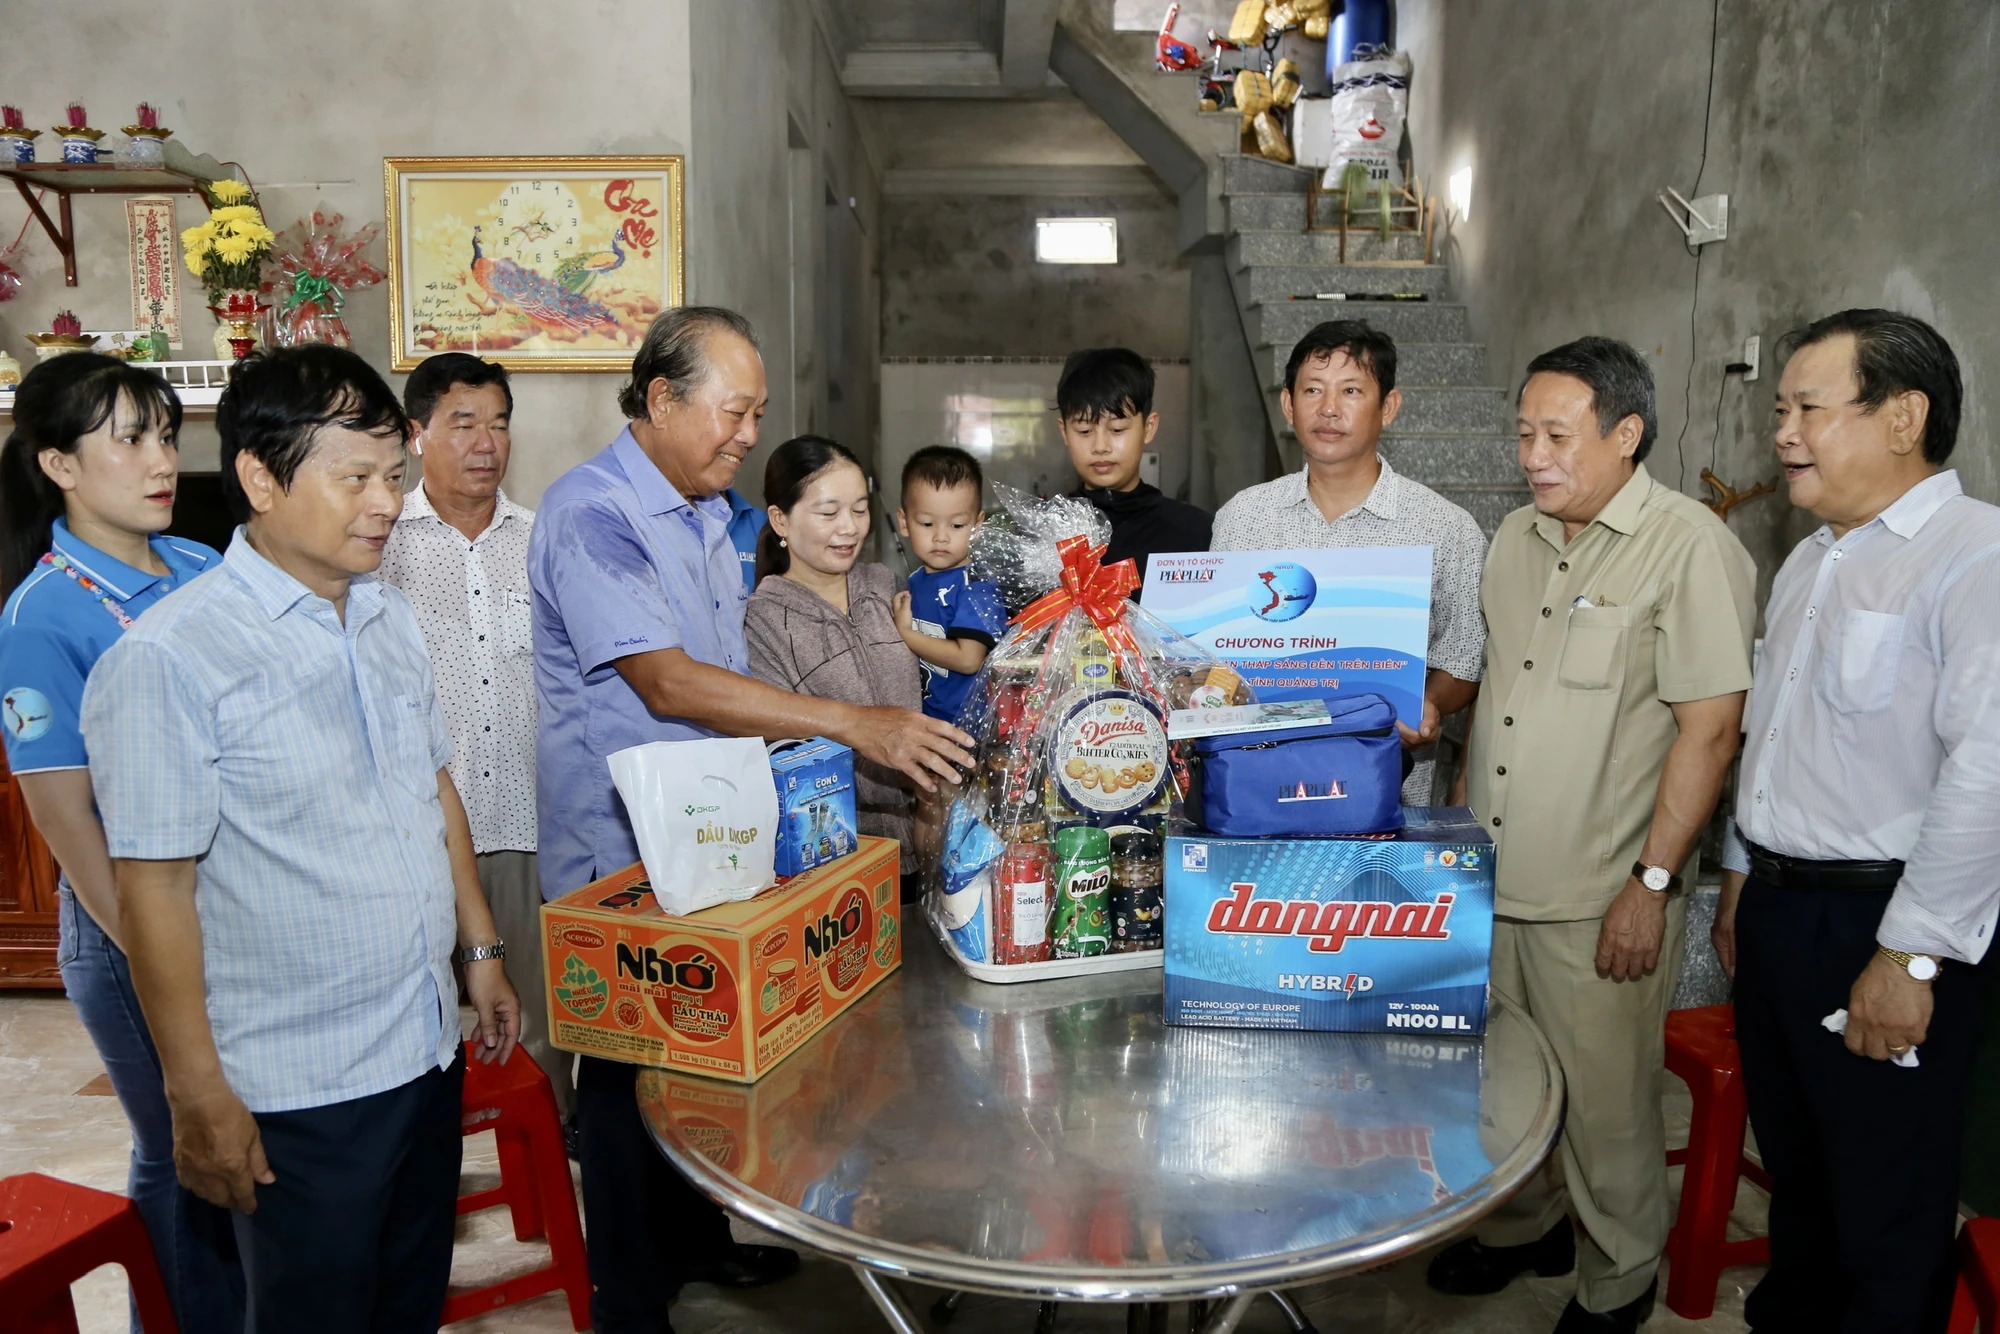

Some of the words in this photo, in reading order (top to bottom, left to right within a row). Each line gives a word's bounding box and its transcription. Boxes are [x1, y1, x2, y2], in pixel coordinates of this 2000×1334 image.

[511, 187, 520, 195] 11
[532, 181, 541, 191] 12
[555, 186, 560, 195] 1
[567, 199, 574, 208] 2
[498, 217, 504, 226] 9
[571, 218, 577, 226] 3
[504, 237, 509, 246] 8
[566, 237, 573, 245] 4
[516, 251, 522, 260] 7
[535, 253, 541, 263] 6
[553, 250, 559, 259] 5
[1215, 637, 1285, 649] CHƯƠNG
[1290, 635, 1338, 649] TRÌNH
[1074, 716, 1148, 746] Danisa
[1077, 747, 1110, 758] BUTTER
[1111, 749, 1149, 759] COOKIES
[697, 820, 724, 845] DẦU
[728, 827, 758, 845] DKGP
[1071, 874, 1109, 893] MILO
[1017, 896, 1044, 905] Select
[1205, 882, 1456, 954] dongnai
[804, 893, 863, 967] Nhớ
[616, 941, 717, 991] Nhớ
[618, 982, 640, 994] mãi
[644, 986, 667, 999] mãi
[565, 994, 605, 1009] TOPPING
[672, 991, 694, 1005] Hương
[695, 995, 703, 1006] vị
[581, 1006, 598, 1015] HƠN
[1181, 1000, 1245, 1010] TECHNOLOGY
[1247, 1003, 1260, 1011] OF
[1262, 1003, 1301, 1012] EUROPE
[1410, 1003, 1440, 1011] 100Ah
[673, 1001, 697, 1018] LẨU
[699, 1008, 728, 1024] THÁI
[1387, 1013, 1439, 1029] N100
[559, 1023, 575, 1031] CÔNG
[650, 1039, 664, 1047] NAM
[785, 1022, 798, 1036] 36%
